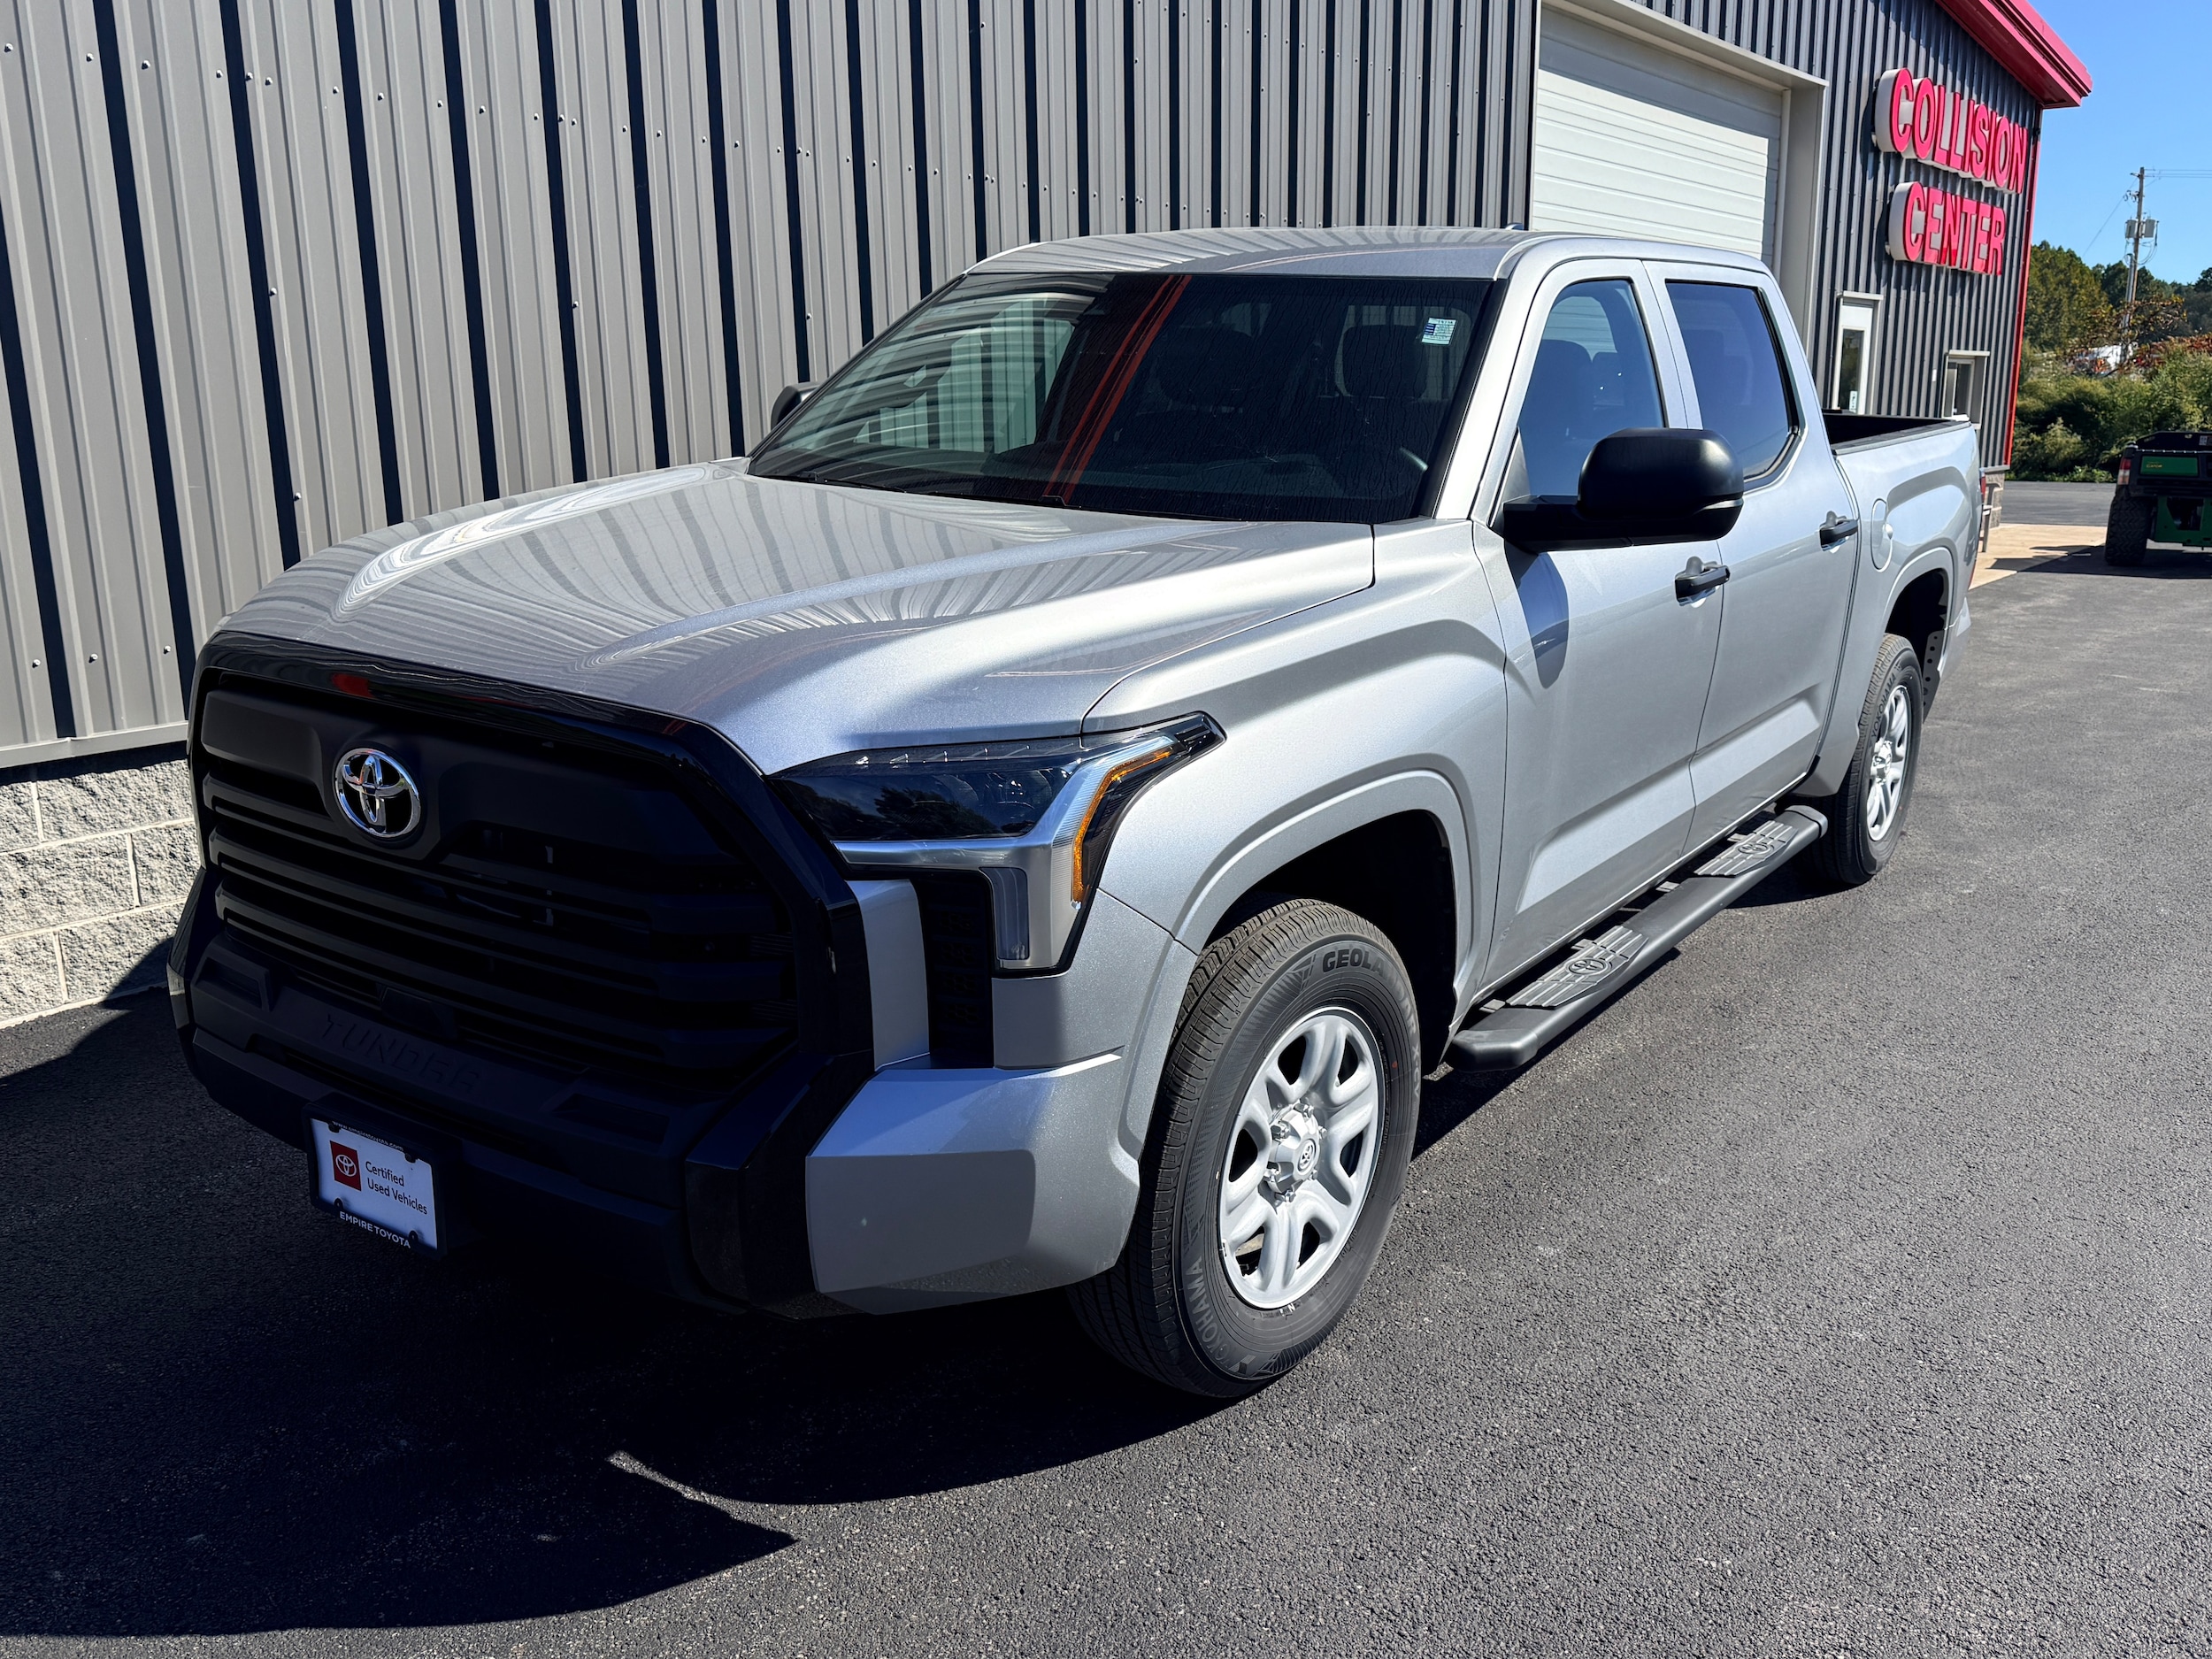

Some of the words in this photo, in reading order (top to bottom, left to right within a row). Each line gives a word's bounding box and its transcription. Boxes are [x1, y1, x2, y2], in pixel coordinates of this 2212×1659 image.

[1889, 67, 2028, 194] COLLISION
[1902, 181, 2007, 276] CENTER
[1322, 948, 1417, 1034] GEOLADAR
[322, 1013, 480, 1094] TUNDRA
[365, 1161, 405, 1187] Certified
[367, 1178, 390, 1197] Used
[392, 1187, 427, 1215] Vehicles
[339, 1211, 373, 1233] EMPIRE
[373, 1225, 411, 1248] TOYOTA
